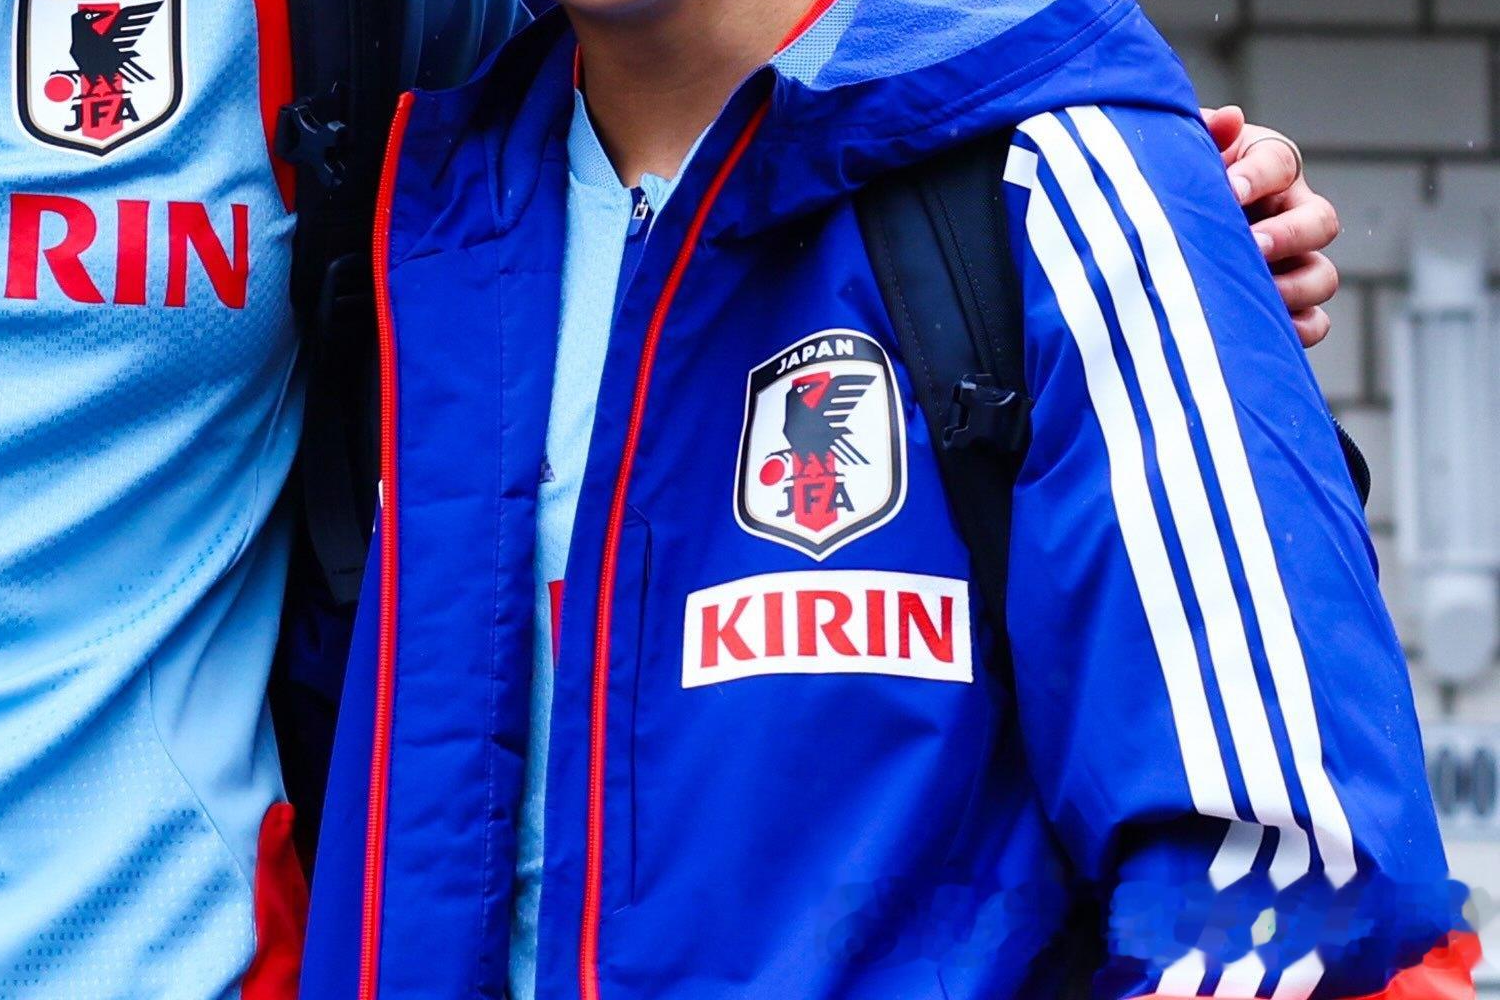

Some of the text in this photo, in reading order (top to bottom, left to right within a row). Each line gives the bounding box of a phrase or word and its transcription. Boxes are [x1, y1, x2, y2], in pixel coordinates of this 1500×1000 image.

[63, 97, 140, 132] JFA
[776, 339, 855, 375] JAPAN
[775, 481, 856, 518] JFA
[700, 589, 955, 668] KIRIN
